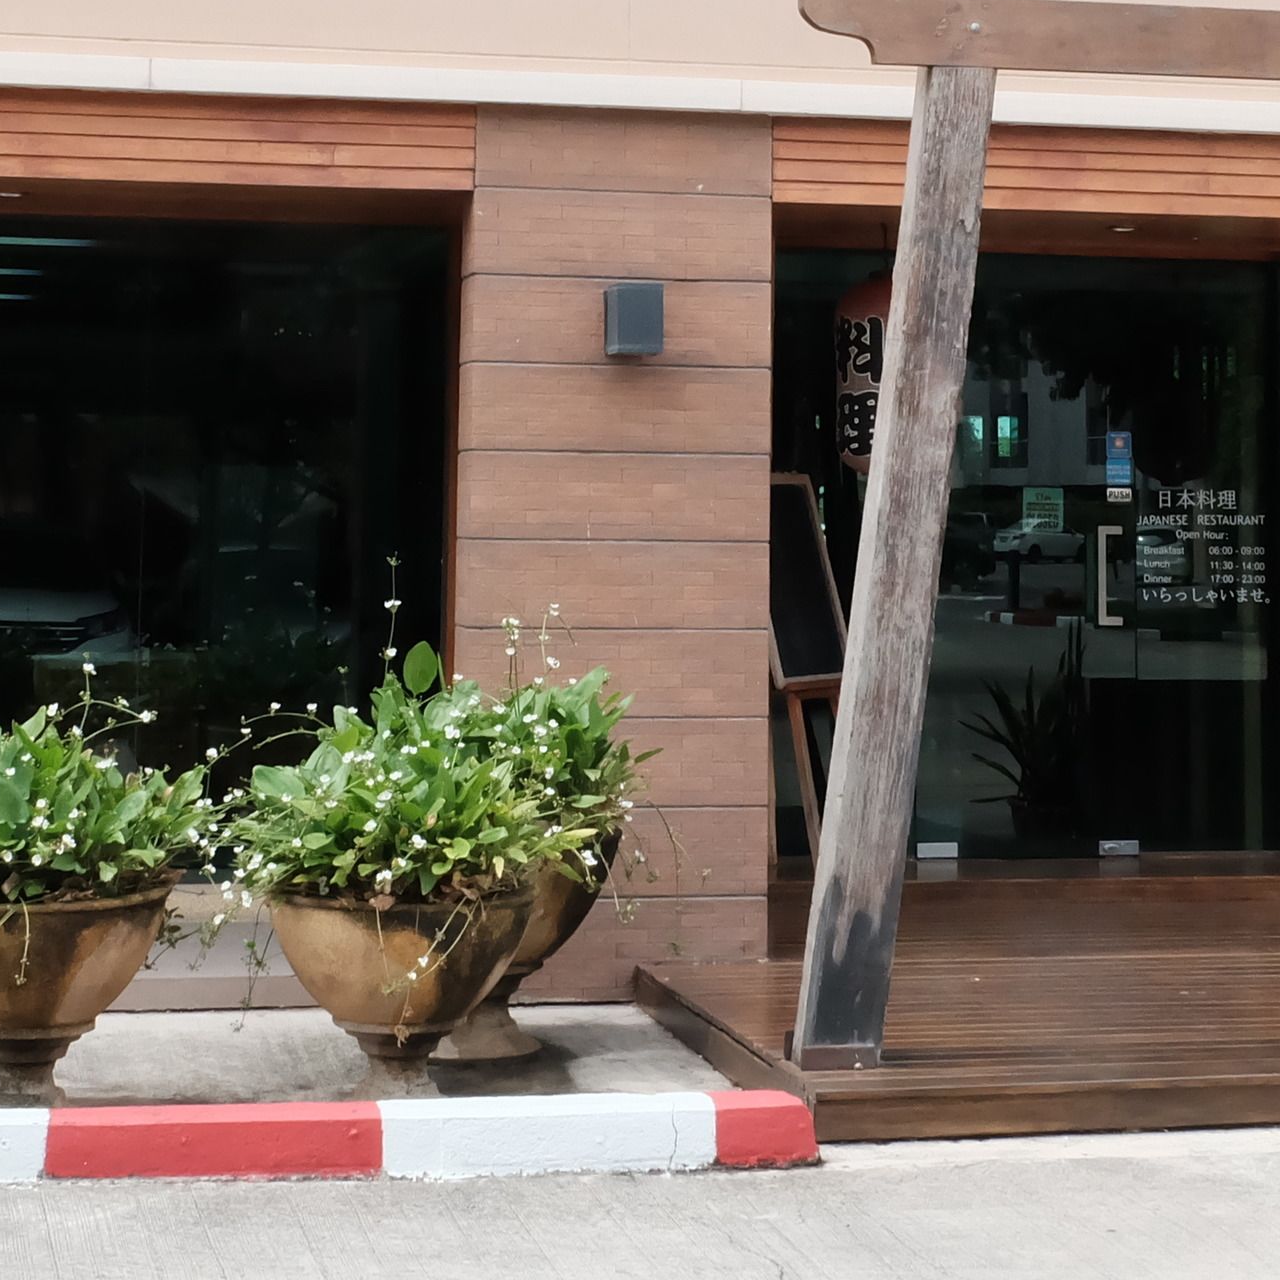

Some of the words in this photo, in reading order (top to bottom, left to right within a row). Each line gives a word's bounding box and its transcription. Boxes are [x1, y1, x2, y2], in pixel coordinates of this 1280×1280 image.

[1108, 489, 1130, 499] PUSH
[1158, 488, 1237, 510] 日本料理
[1136, 514, 1188, 526] JAPANESE
[1197, 514, 1266, 526] RESTAURANT
[1175, 529, 1200, 542] Open
[1203, 530, 1229, 540] Hour:
[1143, 546, 1185, 555] Breakfast
[1208, 546, 1233, 555] 06:00
[1241, 546, 1265, 555] 09:00
[1143, 559, 1170, 568] Lunch
[1210, 561, 1234, 570] 11:30
[1242, 561, 1266, 571] 14:00
[1143, 574, 1172, 583] Dinner
[1211, 575, 1234, 584] 17:00
[1241, 574, 1266, 584] 23:00
[1142, 587, 1270, 604] いらっしゃいませ。
